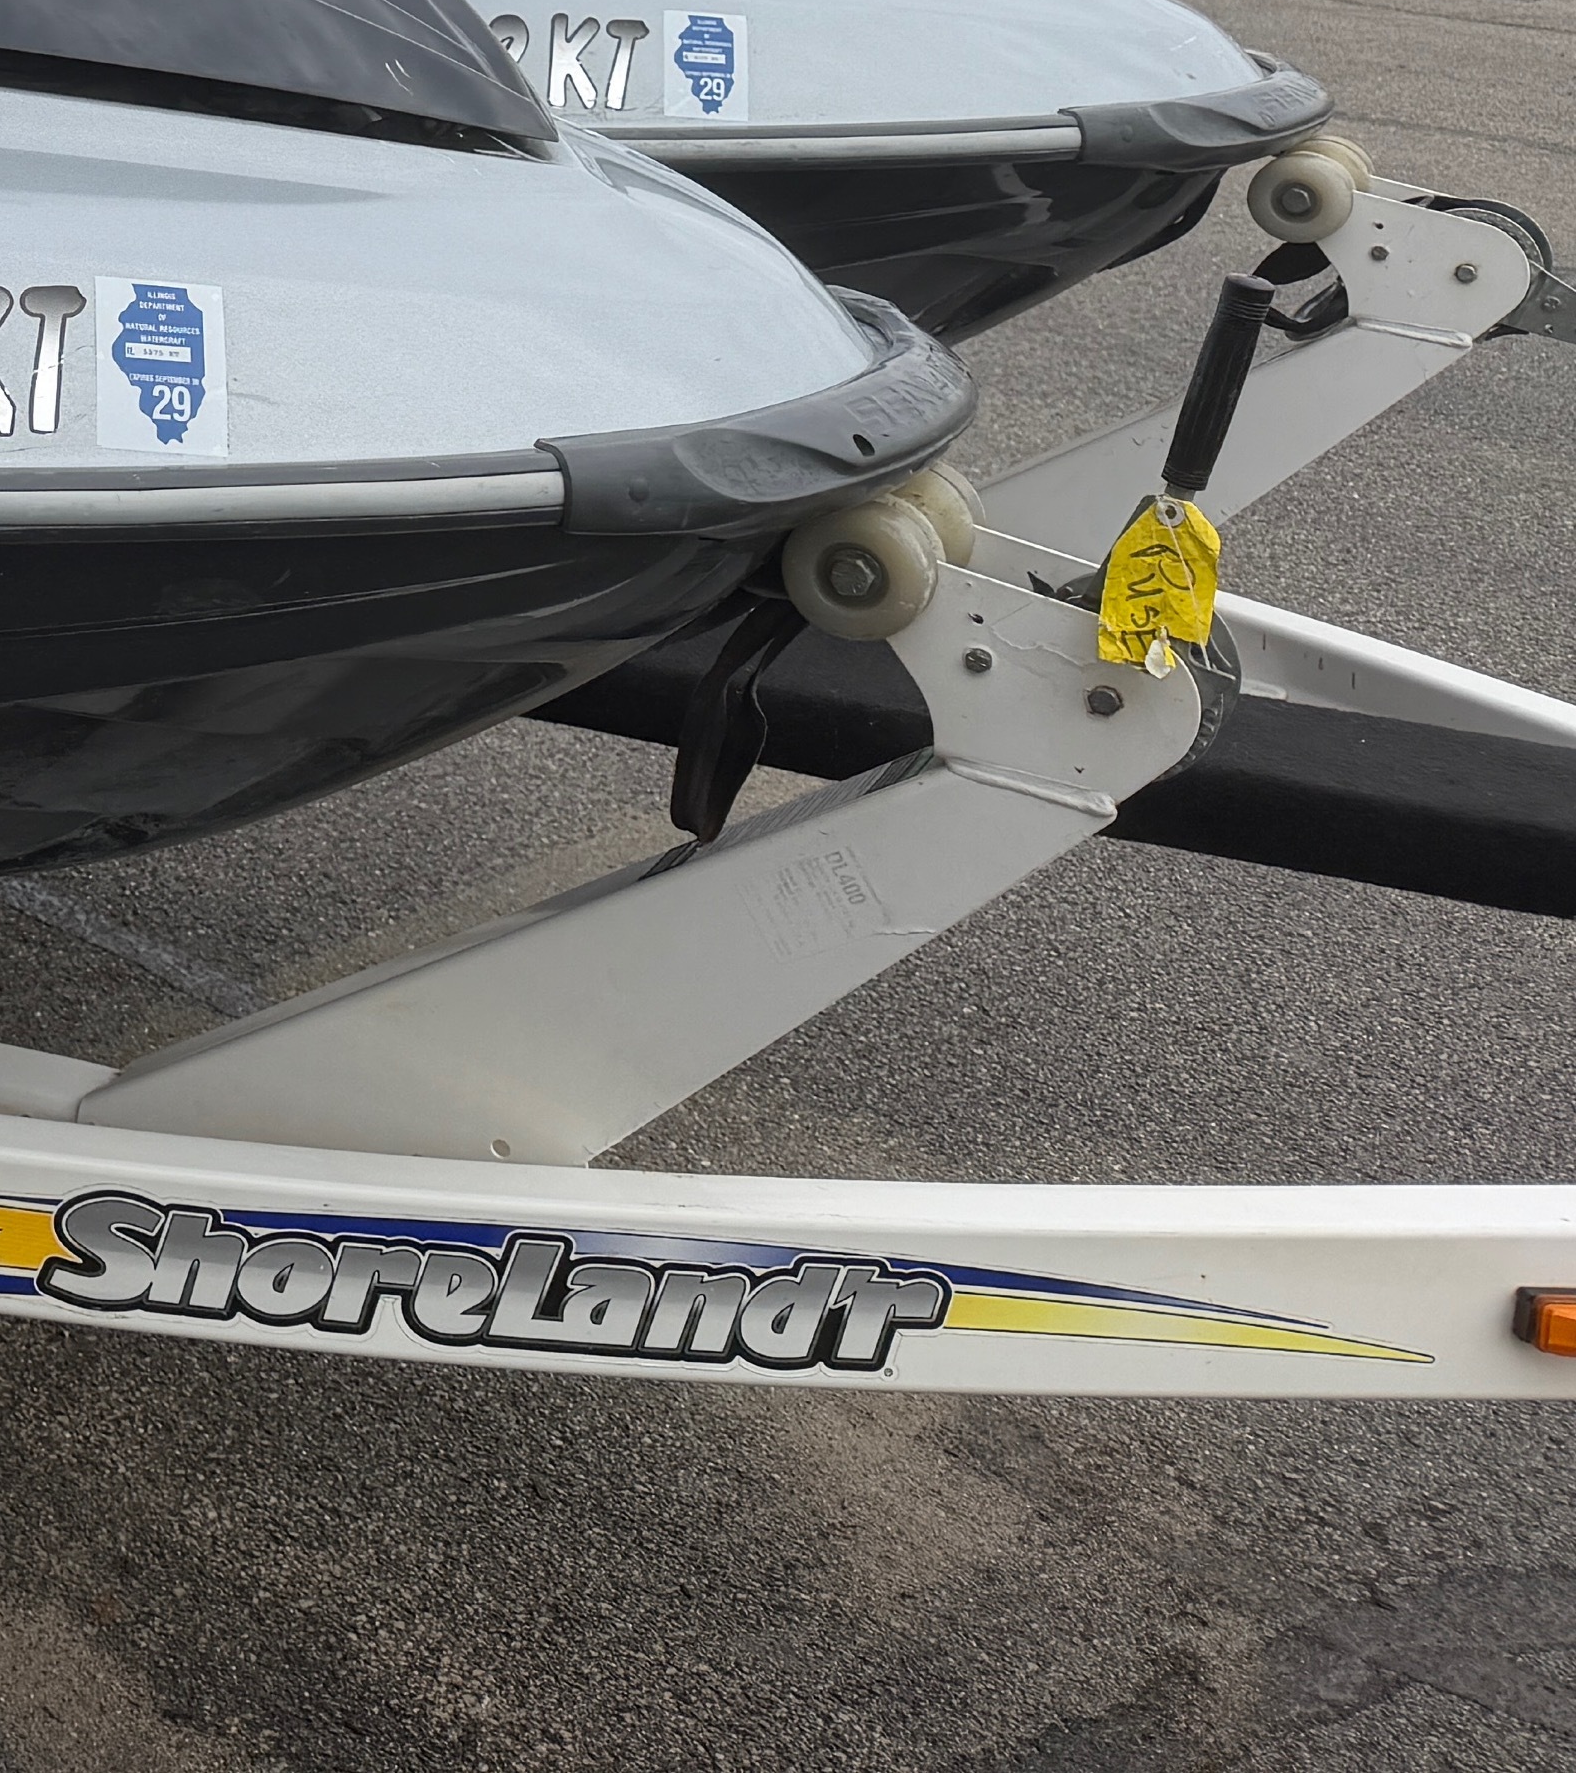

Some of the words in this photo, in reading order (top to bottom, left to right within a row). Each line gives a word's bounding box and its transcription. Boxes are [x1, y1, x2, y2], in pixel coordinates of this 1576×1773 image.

[699, 77, 726, 101] 29
[147, 291, 176, 300] ILLINOIS
[139, 301, 185, 311] DEPARTMENT
[158, 313, 167, 321] OF
[125, 323, 157, 332] NATURAL
[159, 325, 200, 335] RESOURCES
[140, 334, 186, 345] WATERCRAFT
[152, 384, 191, 422] 29
